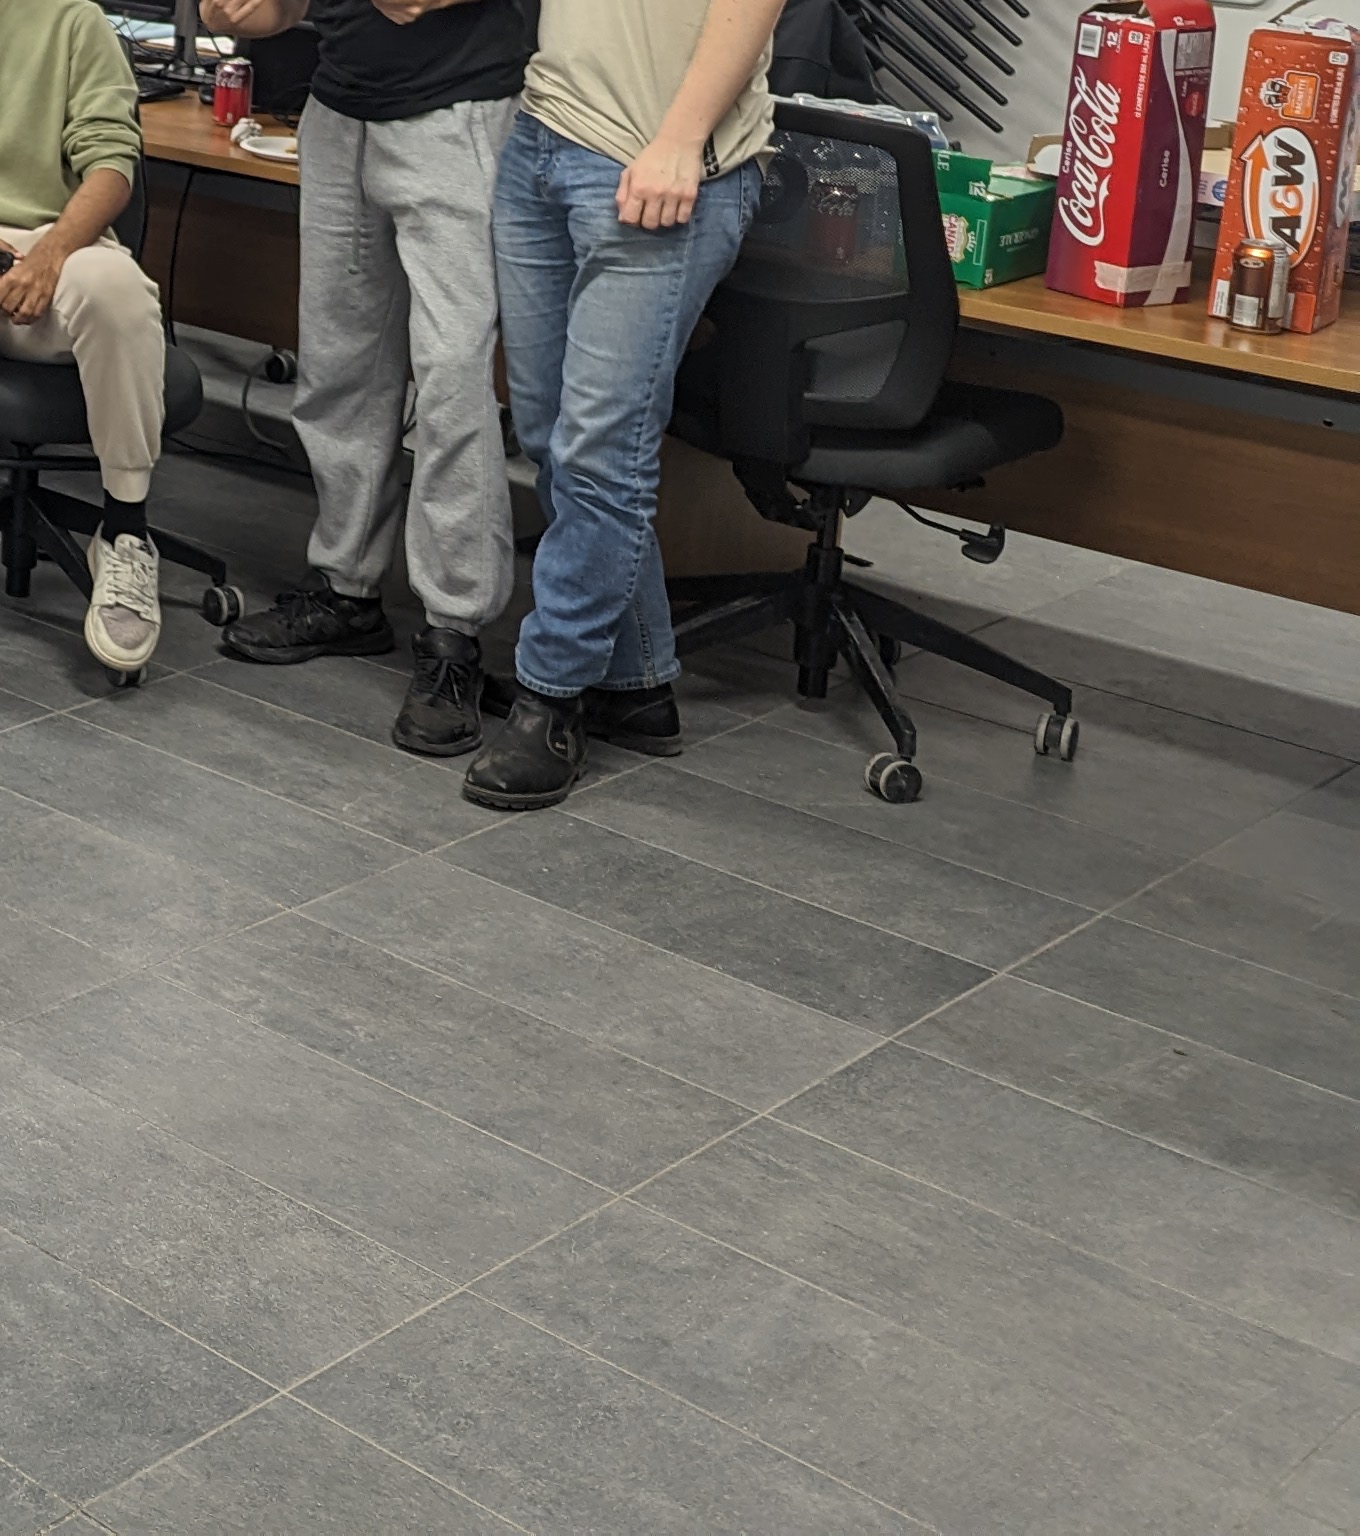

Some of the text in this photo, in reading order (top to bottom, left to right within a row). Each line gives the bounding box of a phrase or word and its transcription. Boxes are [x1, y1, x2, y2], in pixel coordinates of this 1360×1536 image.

[1106, 31, 1119, 48] 12
[937, 150, 951, 172] LE
[1062, 140, 1073, 174] Cerise
[1159, 149, 1171, 188] Cerise
[974, 180, 987, 197] 12
[1269, 135, 1306, 254] A&W
[945, 213, 959, 257] CANAD
